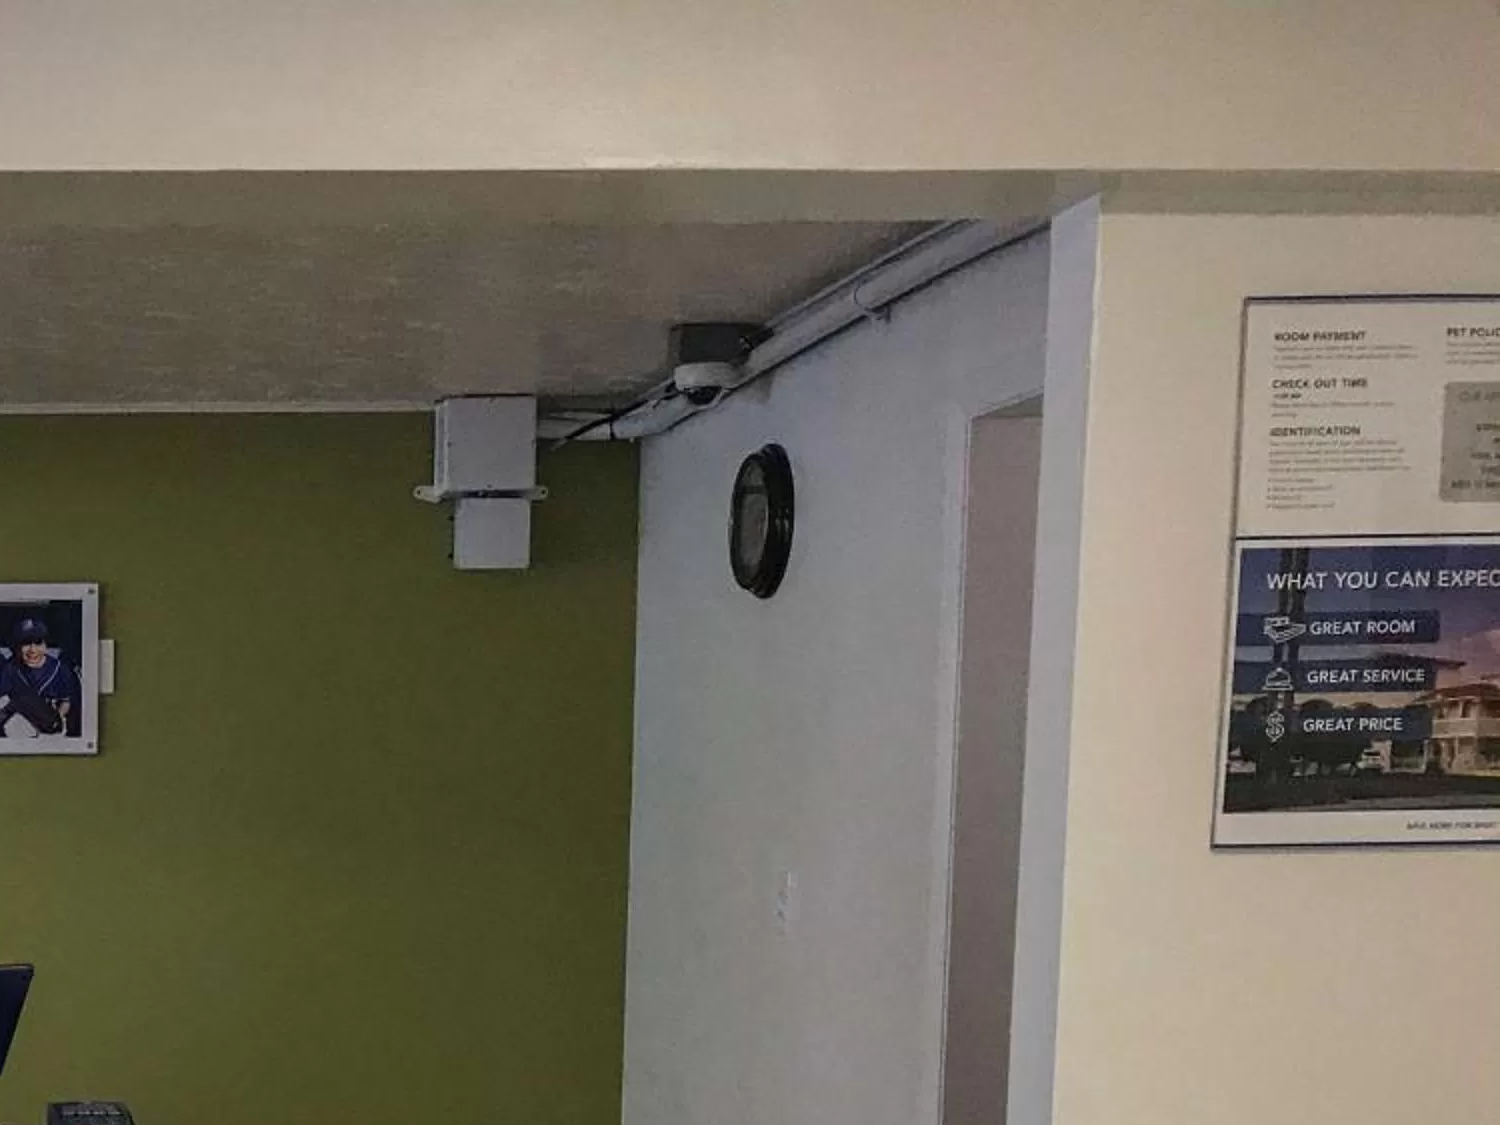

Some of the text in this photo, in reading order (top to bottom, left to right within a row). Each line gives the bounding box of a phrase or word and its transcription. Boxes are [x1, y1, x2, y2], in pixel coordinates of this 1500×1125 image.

[1274, 330, 1367, 342] ROOM PAYMENT
[1447, 327, 1467, 337] PET
[1271, 377, 1368, 389] CHECK OUT TIME
[1269, 426, 1361, 437] IDENTIFICATION
[1266, 572, 1328, 590] WHAT
[1334, 571, 1378, 589] YOU
[1385, 570, 1430, 588] CAN
[1309, 619, 1416, 636] GREAT ROOM
[1306, 668, 1426, 684] GREAT SERVICE
[1302, 717, 1404, 733] GREAT PRICE
